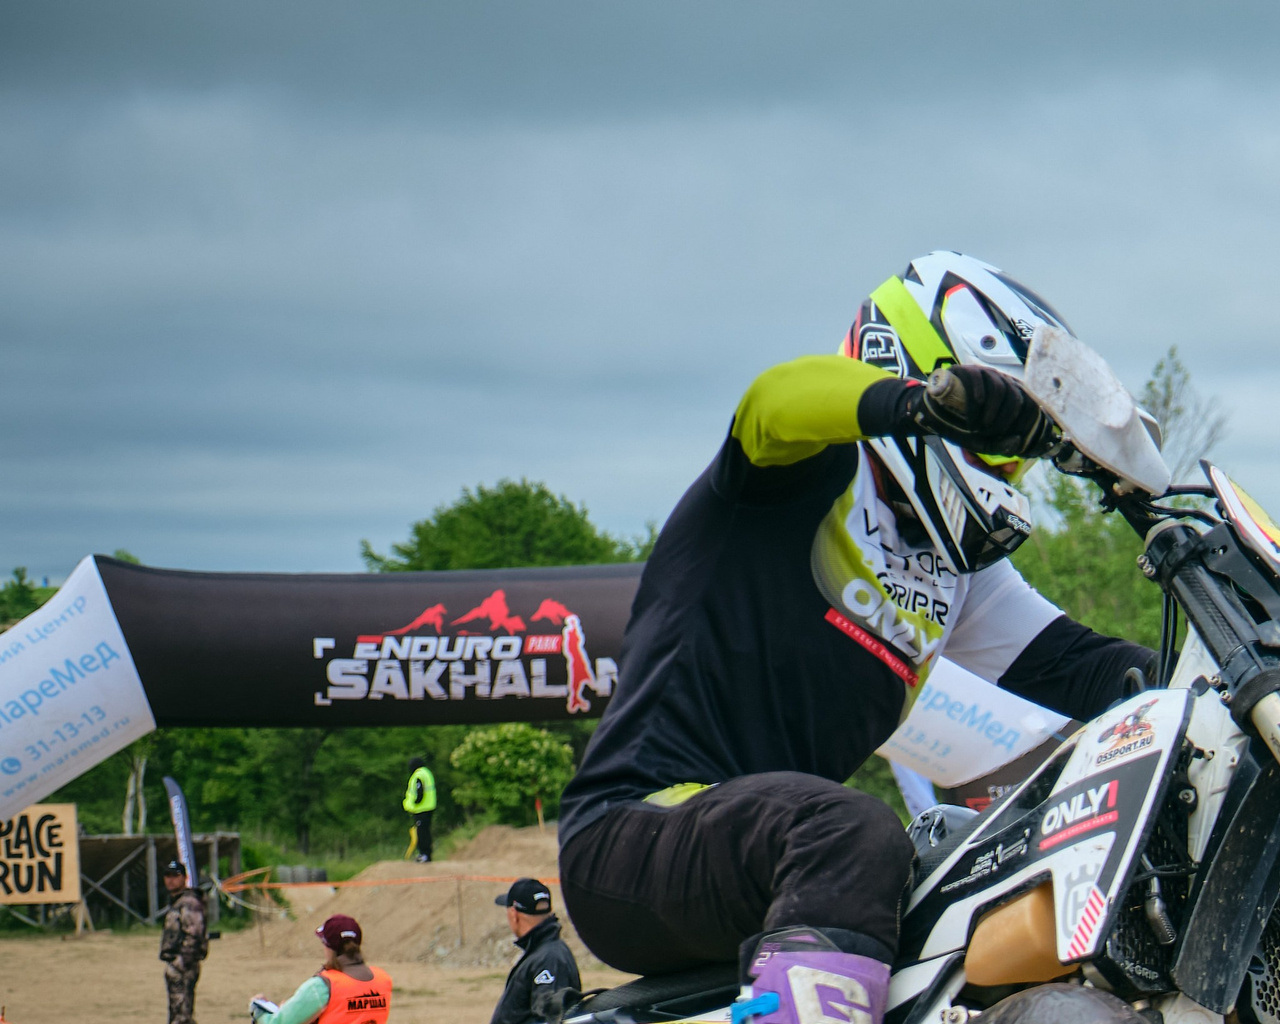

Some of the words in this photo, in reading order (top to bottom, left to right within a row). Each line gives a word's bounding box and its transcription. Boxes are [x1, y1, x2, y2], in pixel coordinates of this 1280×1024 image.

[26, 595, 87, 645] Центр
[842, 578, 940, 667] ONLY
[354, 635, 522, 661] ENDURO
[528, 636, 560, 653] PARK
[25, 704, 107, 762] 31-13-13
[1041, 780, 1119, 835] ONLY1
